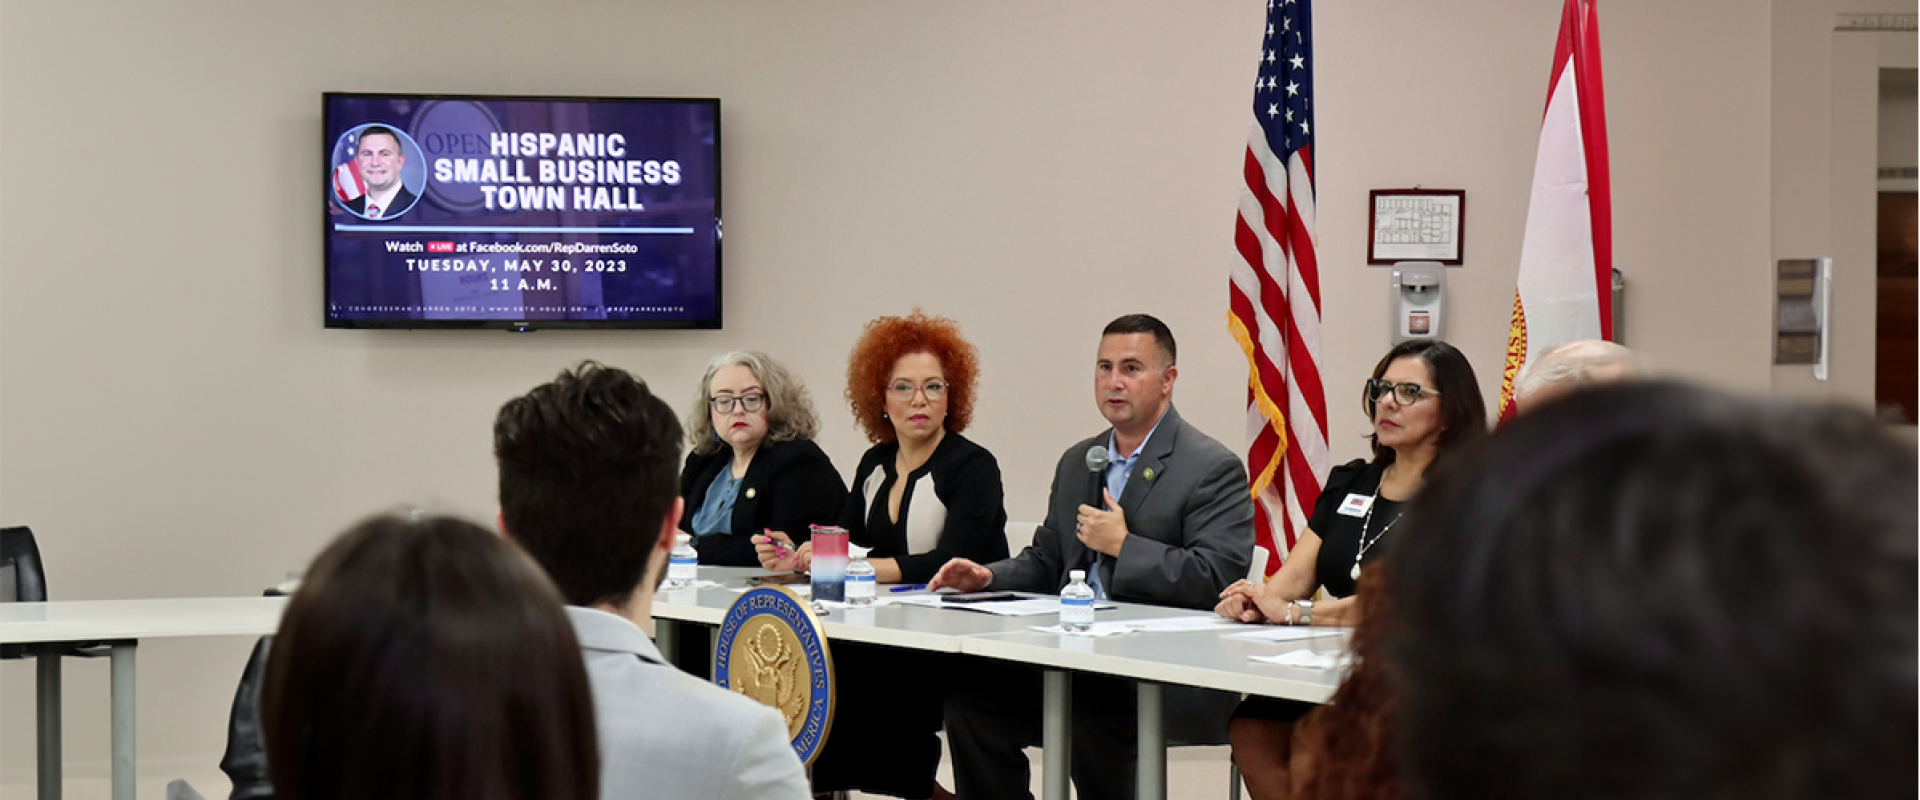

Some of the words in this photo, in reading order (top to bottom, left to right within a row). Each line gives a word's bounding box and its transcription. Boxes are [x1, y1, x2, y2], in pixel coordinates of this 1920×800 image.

[490, 132, 626, 157] HISPANIC
[434, 158, 532, 183] SMALL
[539, 159, 682, 186] BUSINESS
[481, 185, 566, 210] TOWN
[573, 187, 645, 210] HALL
[385, 241, 424, 253] Watch
[437, 243, 453, 251] LIVE
[456, 242, 468, 253] at
[470, 241, 639, 255] Facebook.com/RepDarrenSoto
[406, 259, 497, 273] TUESDAY,
[504, 259, 544, 272] MAY
[551, 260, 578, 274] 30,
[585, 259, 627, 272] 2023
[490, 278, 511, 290] 11
[517, 278, 558, 290] A.M.
[717, 616, 739, 668] HOUSE
[735, 602, 748, 620] OF
[751, 595, 825, 689] REPRESENTATIVES
[796, 699, 823, 755] MERICA
